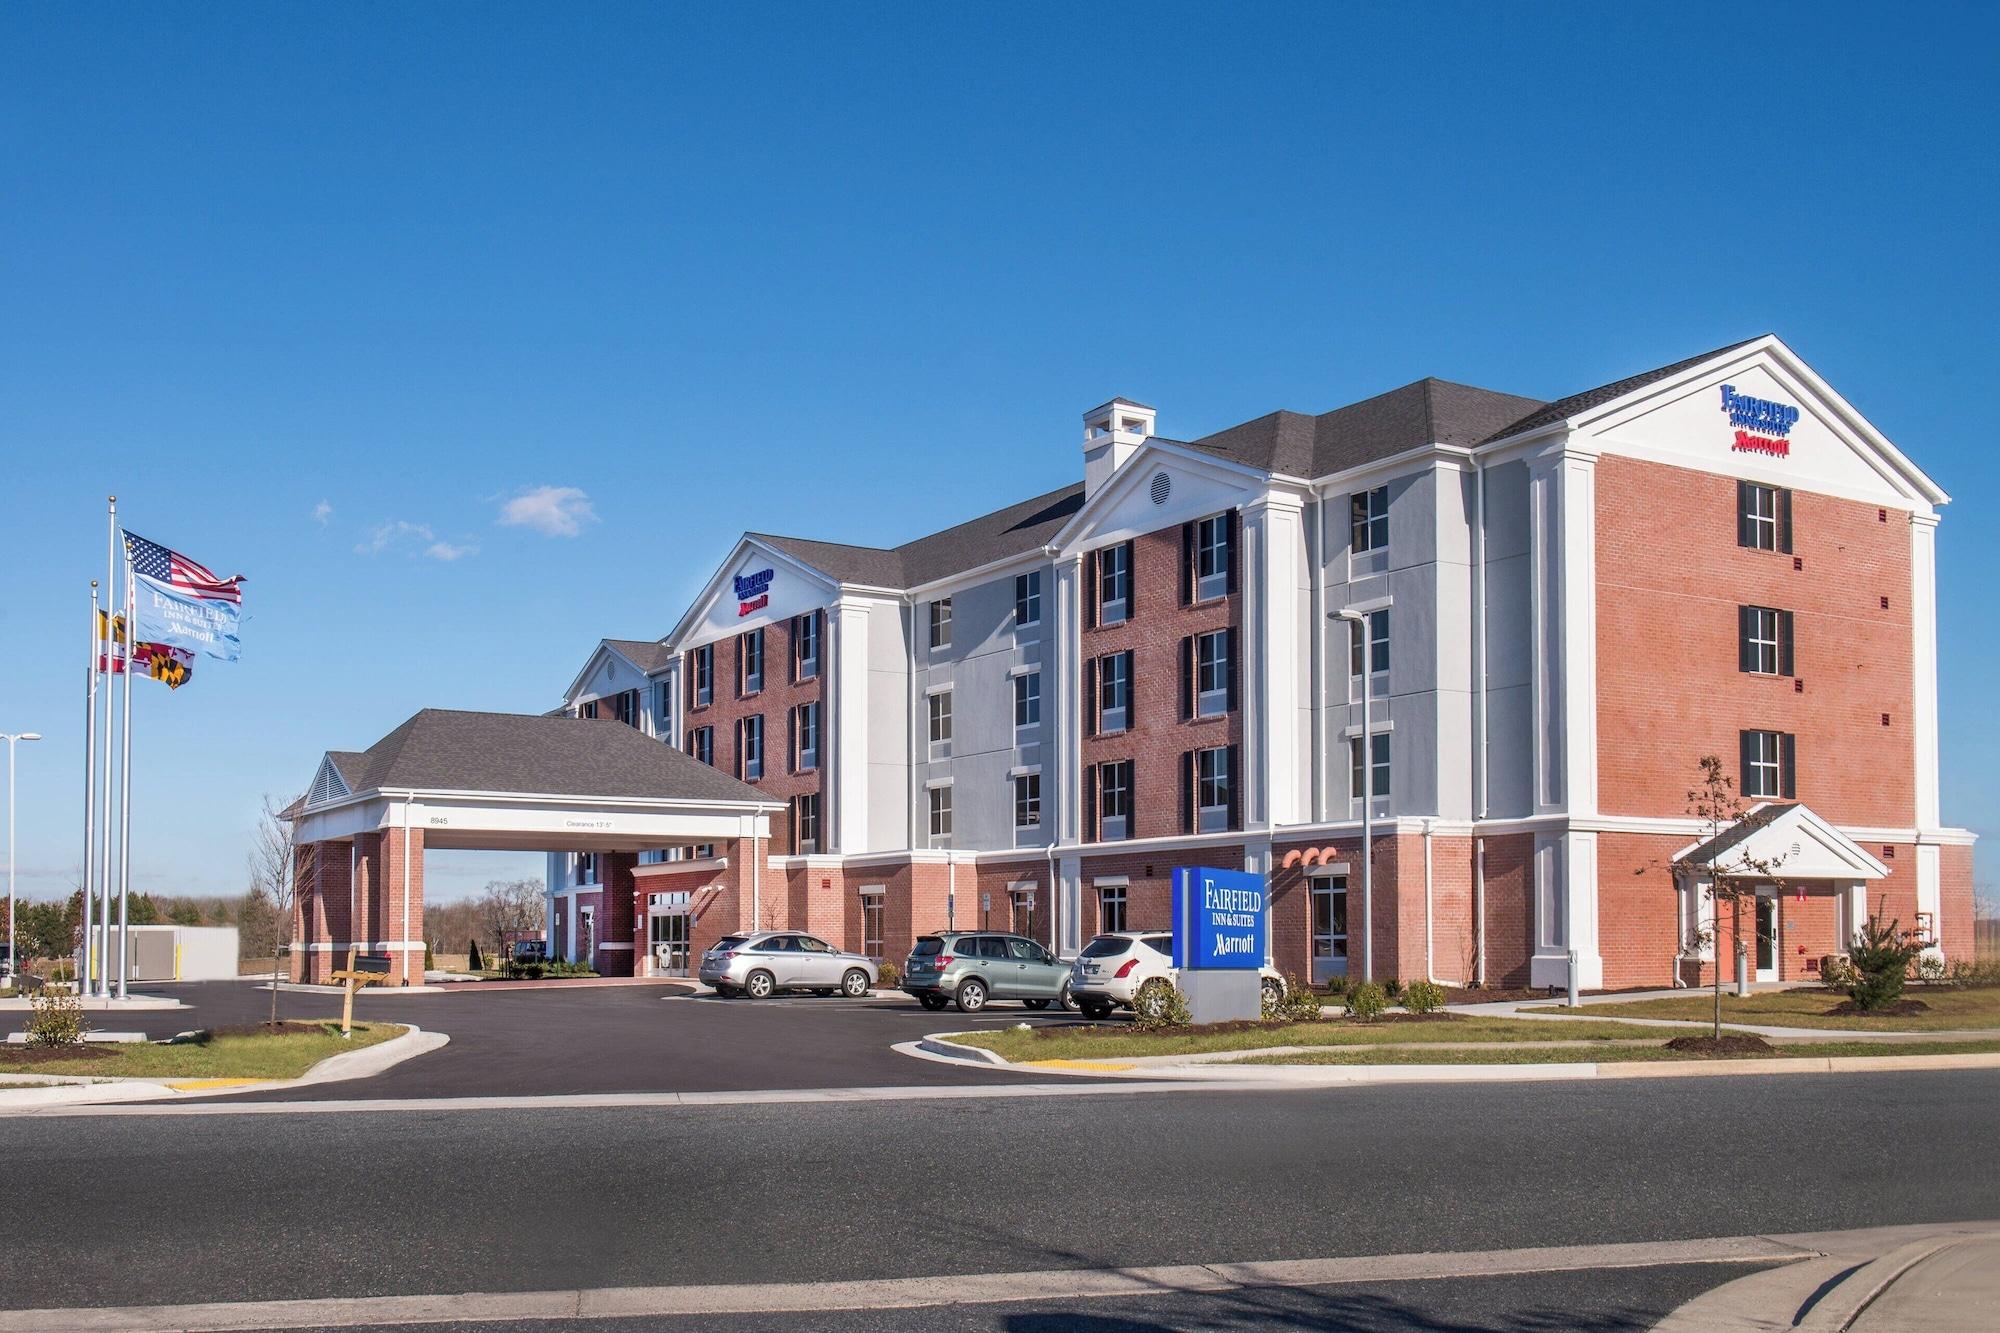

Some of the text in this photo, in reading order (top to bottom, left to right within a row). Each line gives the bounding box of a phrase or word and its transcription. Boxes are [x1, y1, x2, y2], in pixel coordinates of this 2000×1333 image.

[1720, 384, 1799, 423] FAIRFIELD
[1733, 430, 1789, 455] Marriott
[153, 592, 227, 625] FAIRFIELD
[167, 622, 213, 643] Marriott
[430, 817, 448, 825] 8945
[566, 820, 595, 828] Clearance
[1205, 879, 1261, 913] FAIRFIELD
[1213, 933, 1254, 956] Marriott
